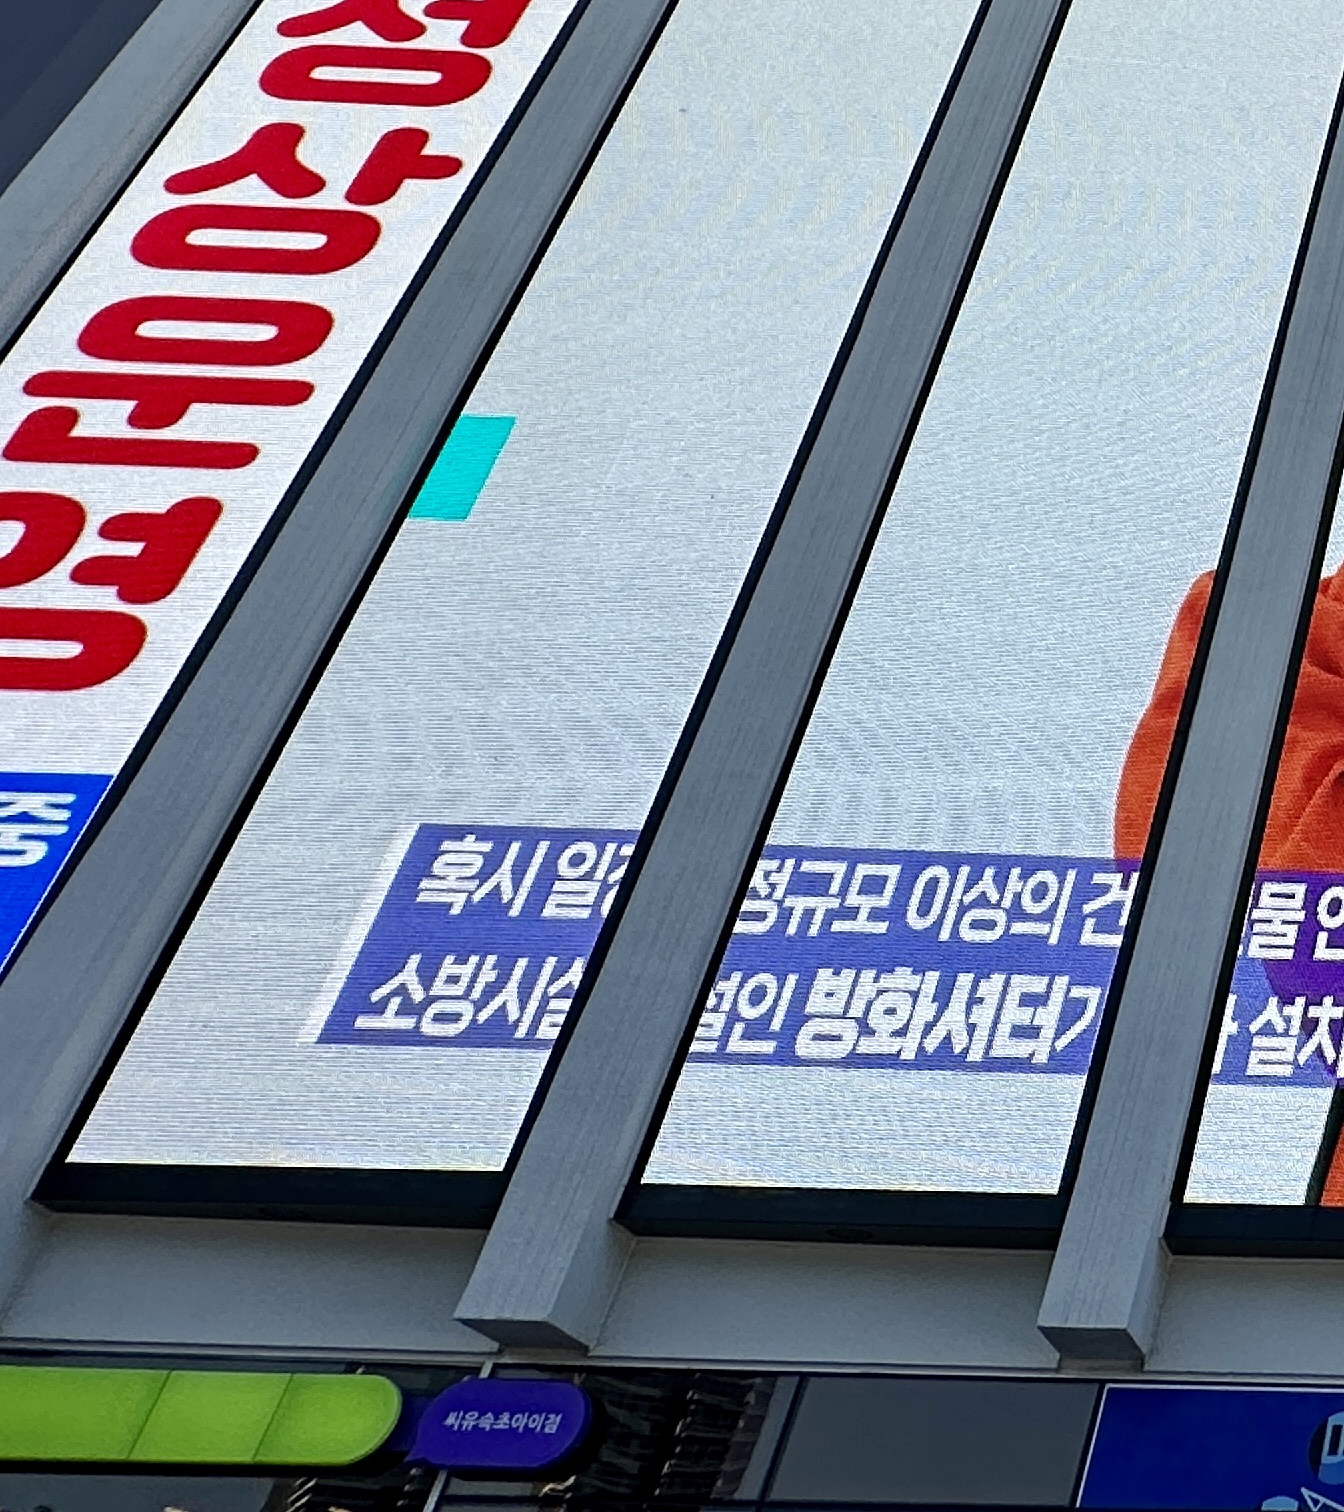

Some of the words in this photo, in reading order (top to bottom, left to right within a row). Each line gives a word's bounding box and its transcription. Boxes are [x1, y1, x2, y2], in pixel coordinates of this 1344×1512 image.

[415, 834, 550, 917] 혹시
[906, 865, 1079, 945] 이상의
[442, 1409, 563, 1434] 씨유속초아이점
